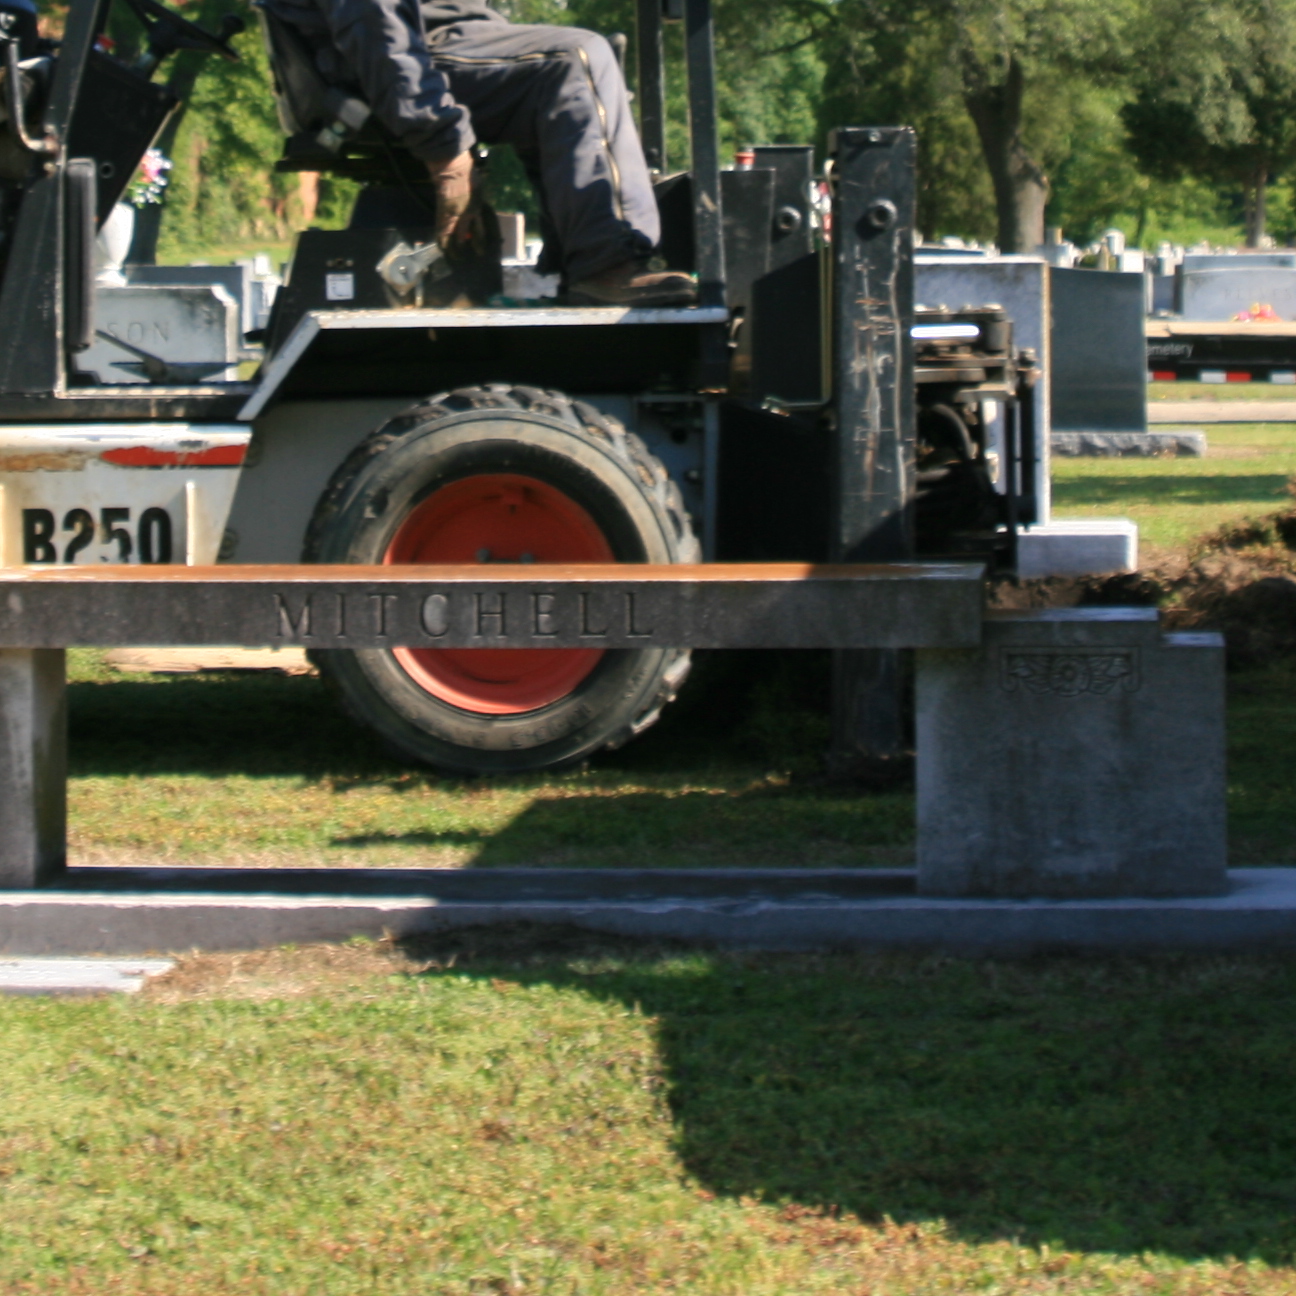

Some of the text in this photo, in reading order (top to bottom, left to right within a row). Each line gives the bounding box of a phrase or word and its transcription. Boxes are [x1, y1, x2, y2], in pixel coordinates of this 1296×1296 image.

[94, 321, 170, 344] SON
[22, 506, 173, 565] B250
[271, 592, 655, 640] MITCHELL
